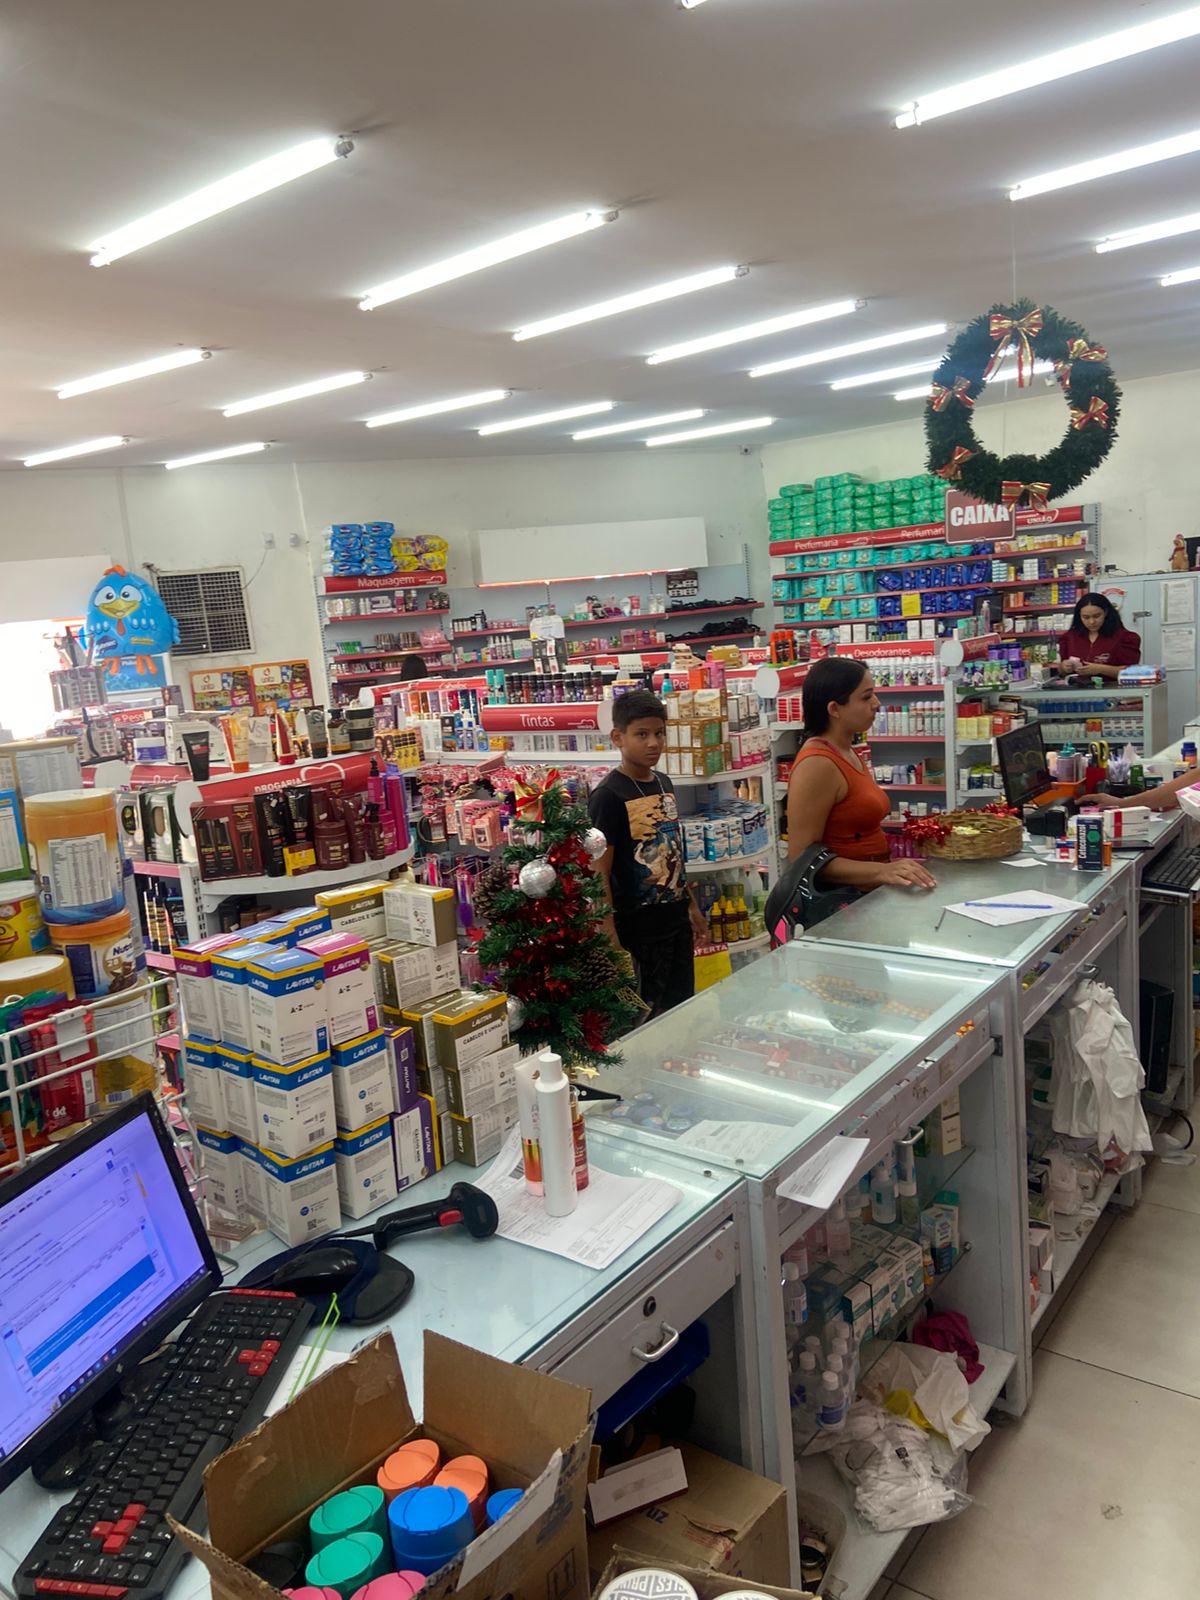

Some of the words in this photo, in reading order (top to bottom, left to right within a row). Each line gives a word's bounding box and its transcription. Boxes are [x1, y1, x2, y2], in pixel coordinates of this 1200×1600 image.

[950, 503, 1010, 527] CAIXA
[901, 526, 945, 539] Perfumari
[795, 538, 839, 551] Perfumaria
[358, 576, 415, 588] Maquiagem
[748, 652, 767, 661] Pess
[854, 647, 912, 658] Desodorantes
[122, 713, 144, 723] Pess
[520, 714, 555, 727] Tintas
[254, 777, 302, 793] DROGARIA
[298, 923, 324, 937] LAVITAN
[332, 957, 361, 972] LAVITAN
[285, 976, 316, 990] LAVITAN
[353, 1042, 378, 1059] LAVITAN
[259, 1074, 281, 1085] LAVITAN
[297, 1066, 324, 1083] LAVITAN
[359, 1130, 383, 1148] LAVITAN
[424, 1126, 432, 1153] LAVITAN
[296, 1158, 326, 1175] LAVITAN
